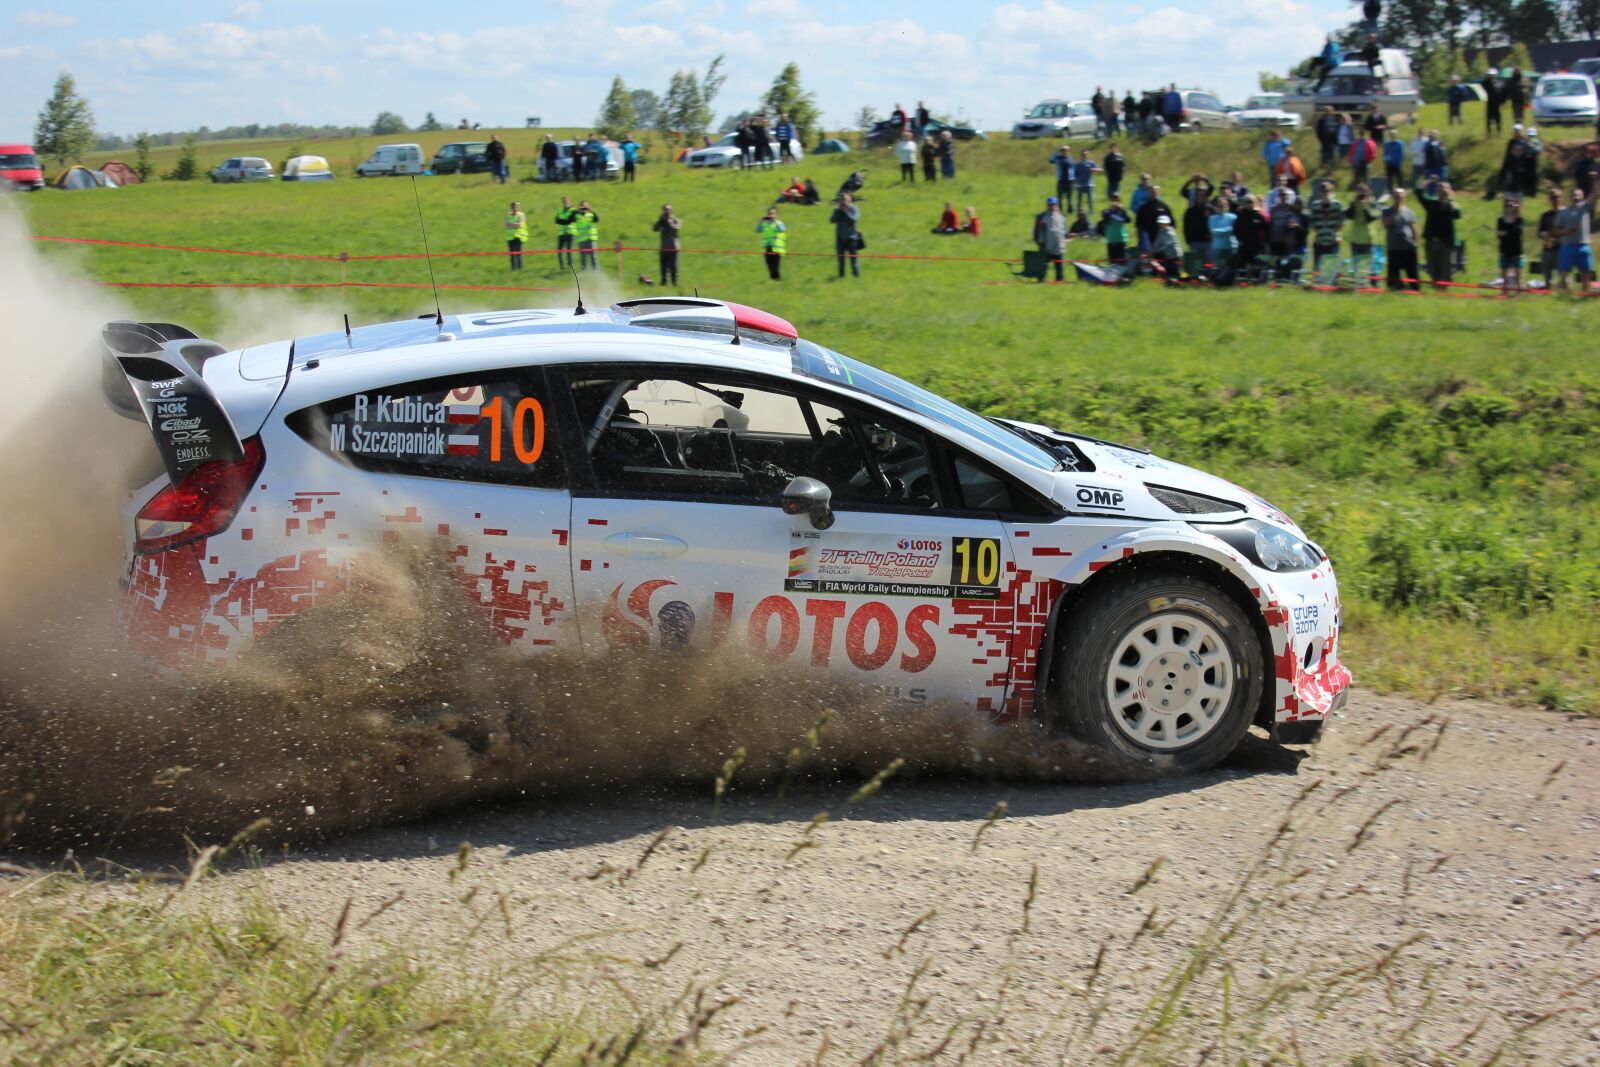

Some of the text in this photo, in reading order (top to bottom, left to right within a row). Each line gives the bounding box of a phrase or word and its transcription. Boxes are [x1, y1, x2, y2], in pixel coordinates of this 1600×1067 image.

[157, 402, 188, 414] NGK
[354, 395, 446, 424] R Kubica
[161, 417, 201, 431] Eibach
[481, 396, 545, 465] 10
[331, 424, 445, 458] M Szczepaniak
[176, 446, 209, 462] ENDLESS
[1076, 487, 1125, 506] OMP
[911, 540, 942, 551] LOTOS
[845, 550, 882, 567] Rally
[884, 551, 940, 568] Poland
[956, 538, 998, 586] 10
[881, 567, 902, 579] Rajd
[902, 568, 932, 579] Polski
[825, 582, 950, 597] FIA World Rally Championship
